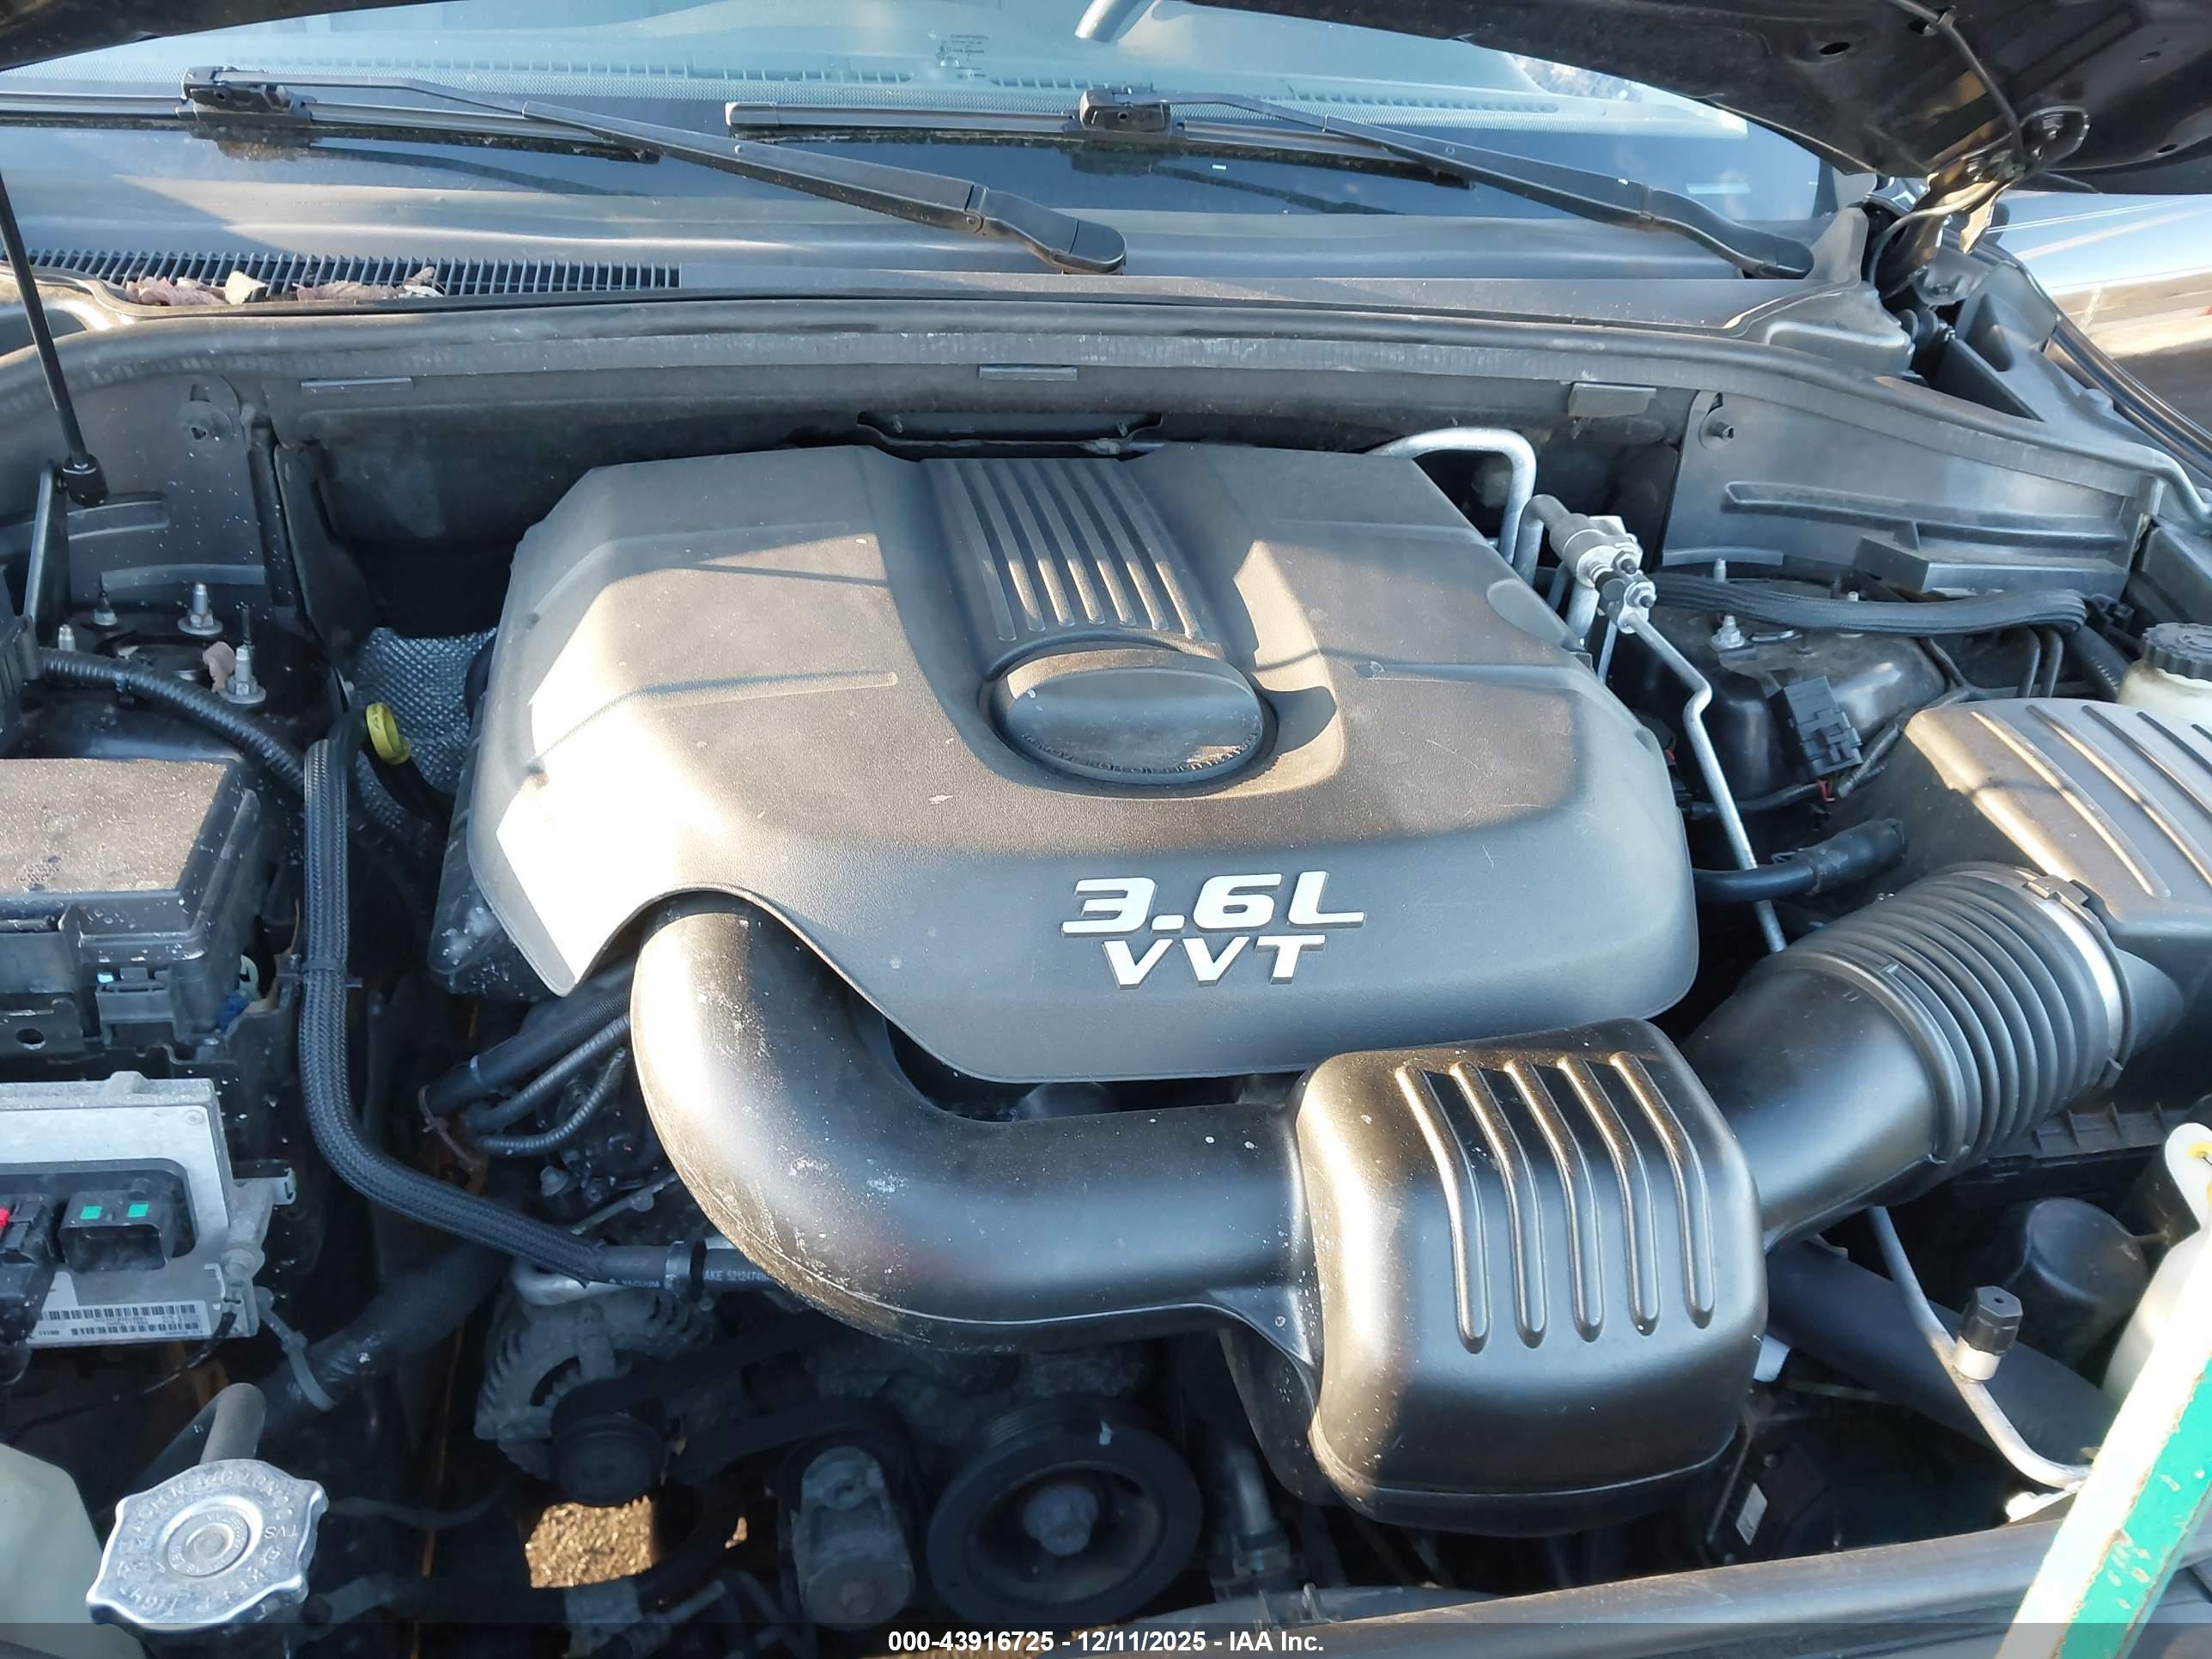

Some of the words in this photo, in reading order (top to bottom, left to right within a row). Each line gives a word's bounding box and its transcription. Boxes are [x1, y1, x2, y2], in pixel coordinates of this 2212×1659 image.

[1060, 871, 1366, 937] 3.6L
[1102, 934, 1327, 989] VVT
[264, 1523, 300, 1540] TVS
